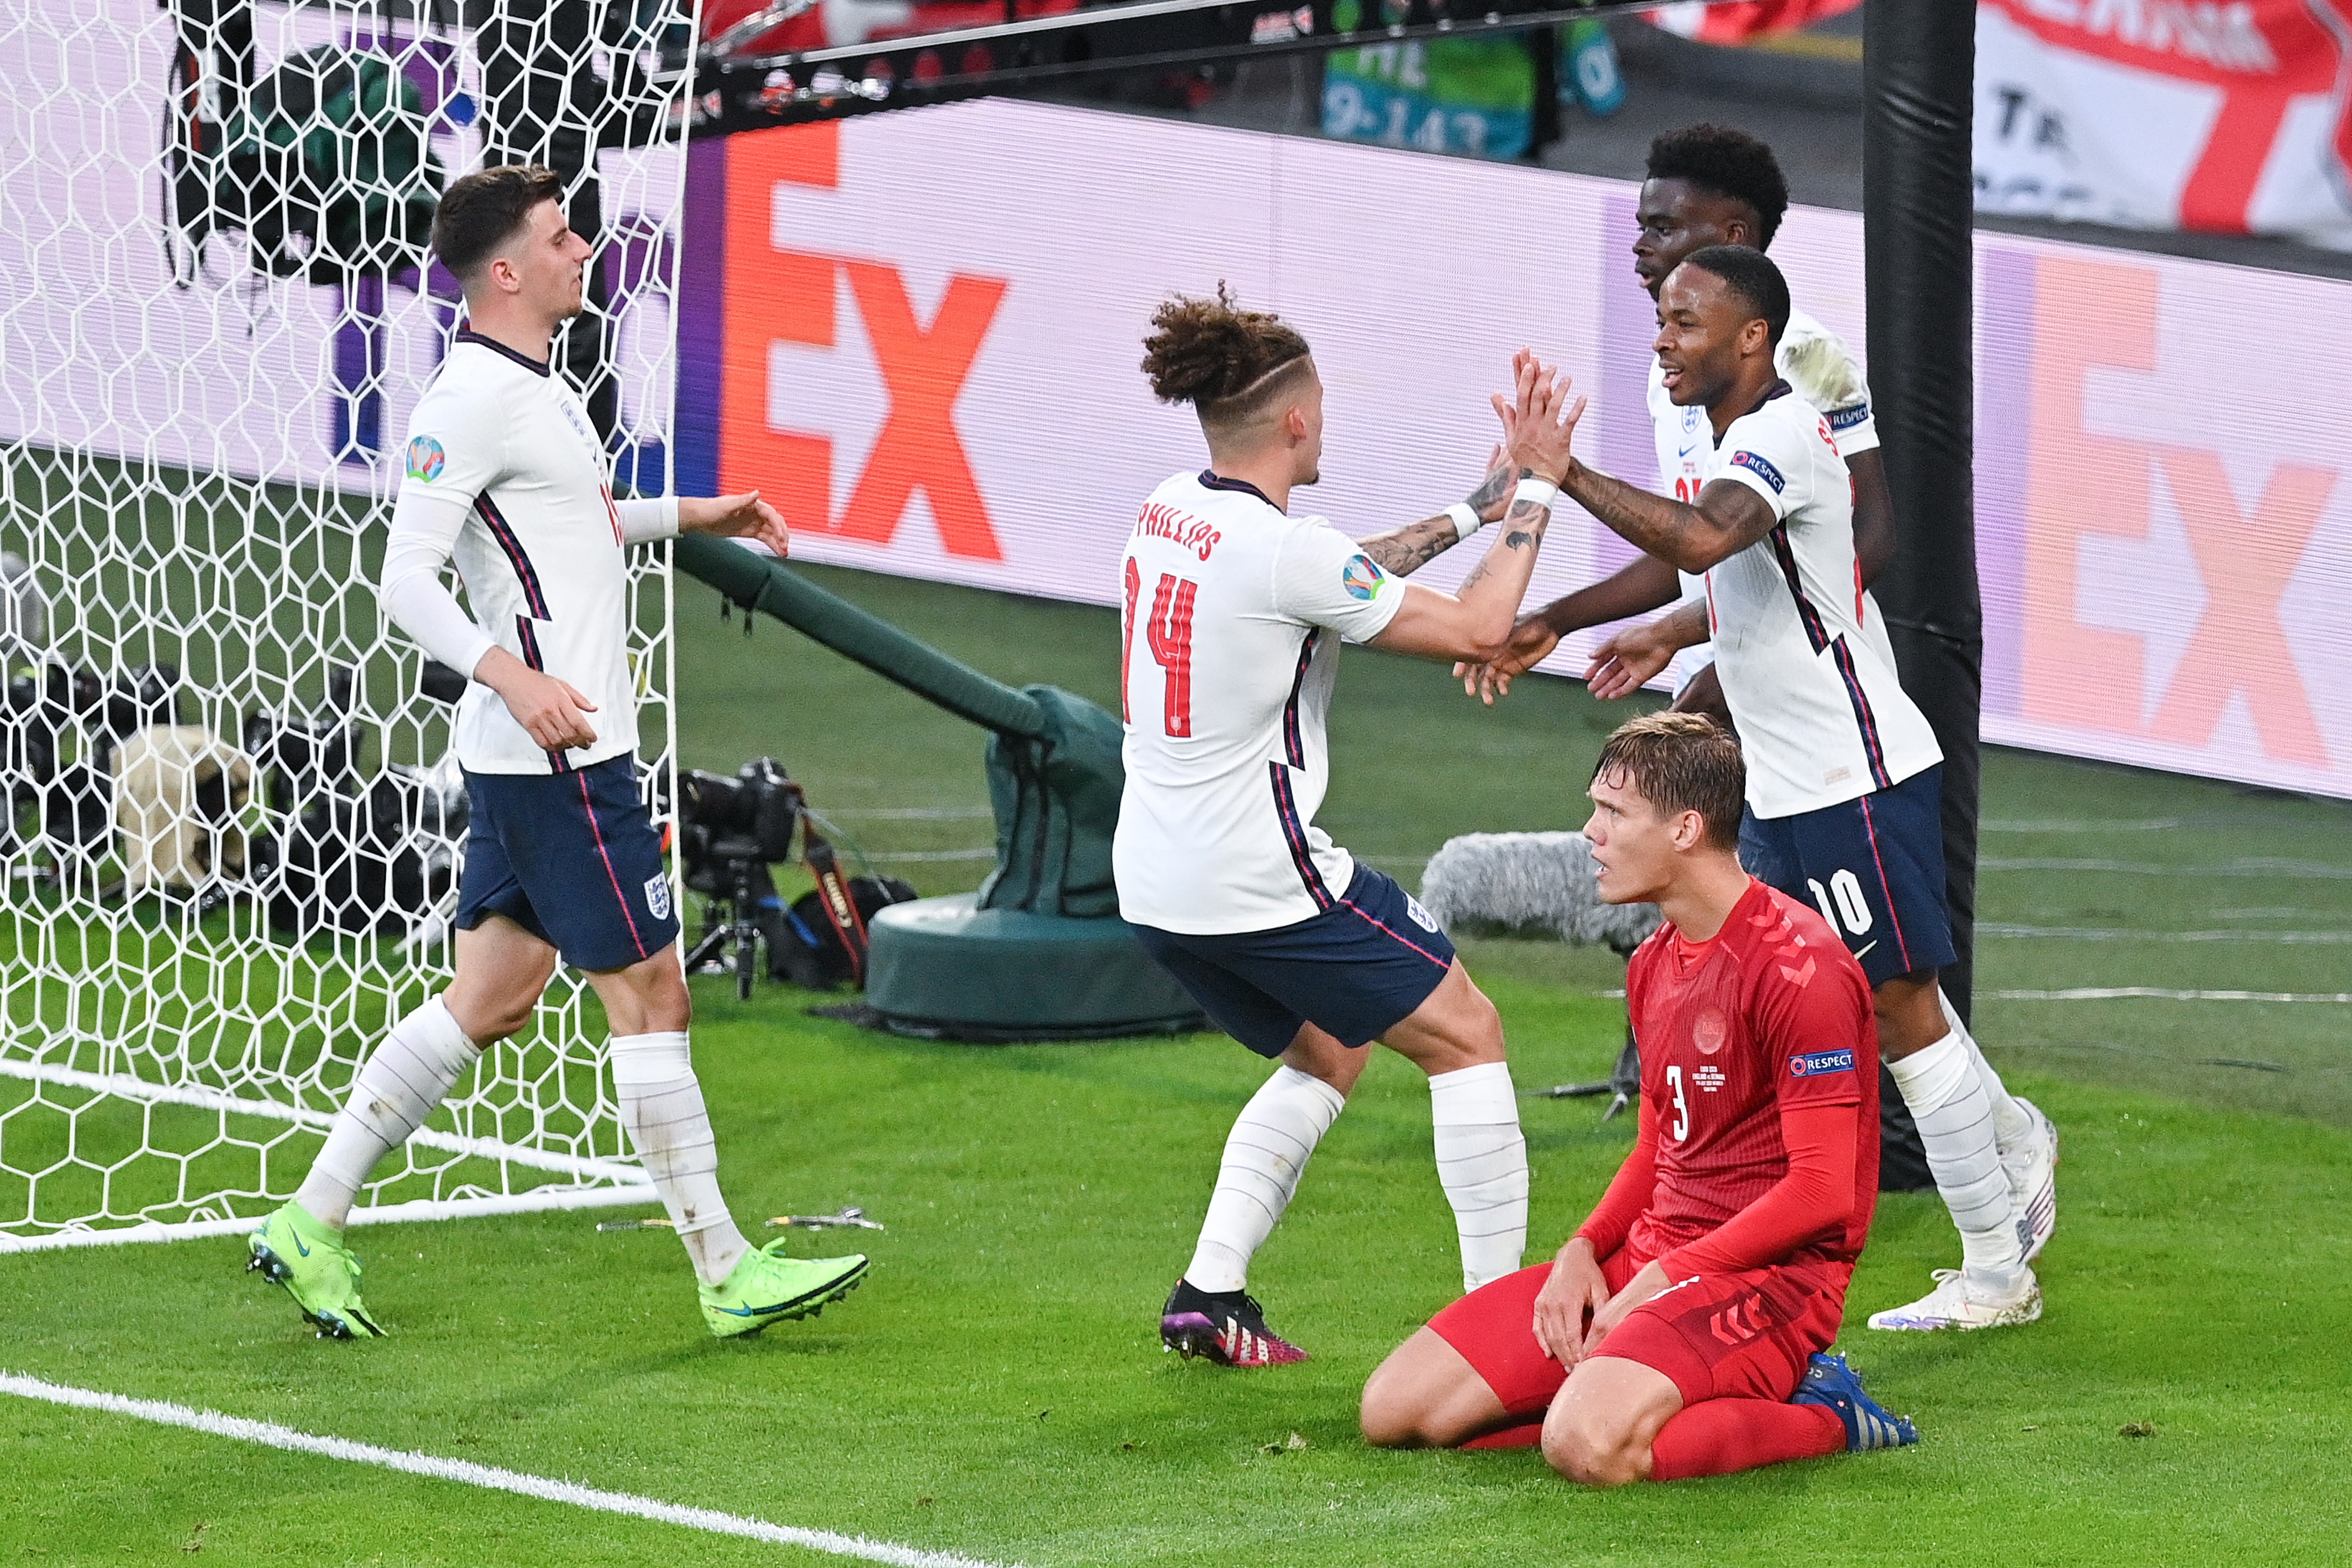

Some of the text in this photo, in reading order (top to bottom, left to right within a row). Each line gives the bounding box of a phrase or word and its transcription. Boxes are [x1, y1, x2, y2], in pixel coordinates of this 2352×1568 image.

[1832, 407, 1867, 425] RESPECT
[1747, 456, 1784, 491] RESPECT
[1136, 502, 1221, 562] PHILLIPS
[1122, 556, 1198, 738] 14
[1806, 868, 1873, 941] 10
[1807, 1054, 1852, 1070] RESPECT
[1666, 1065, 1689, 1142] 3
